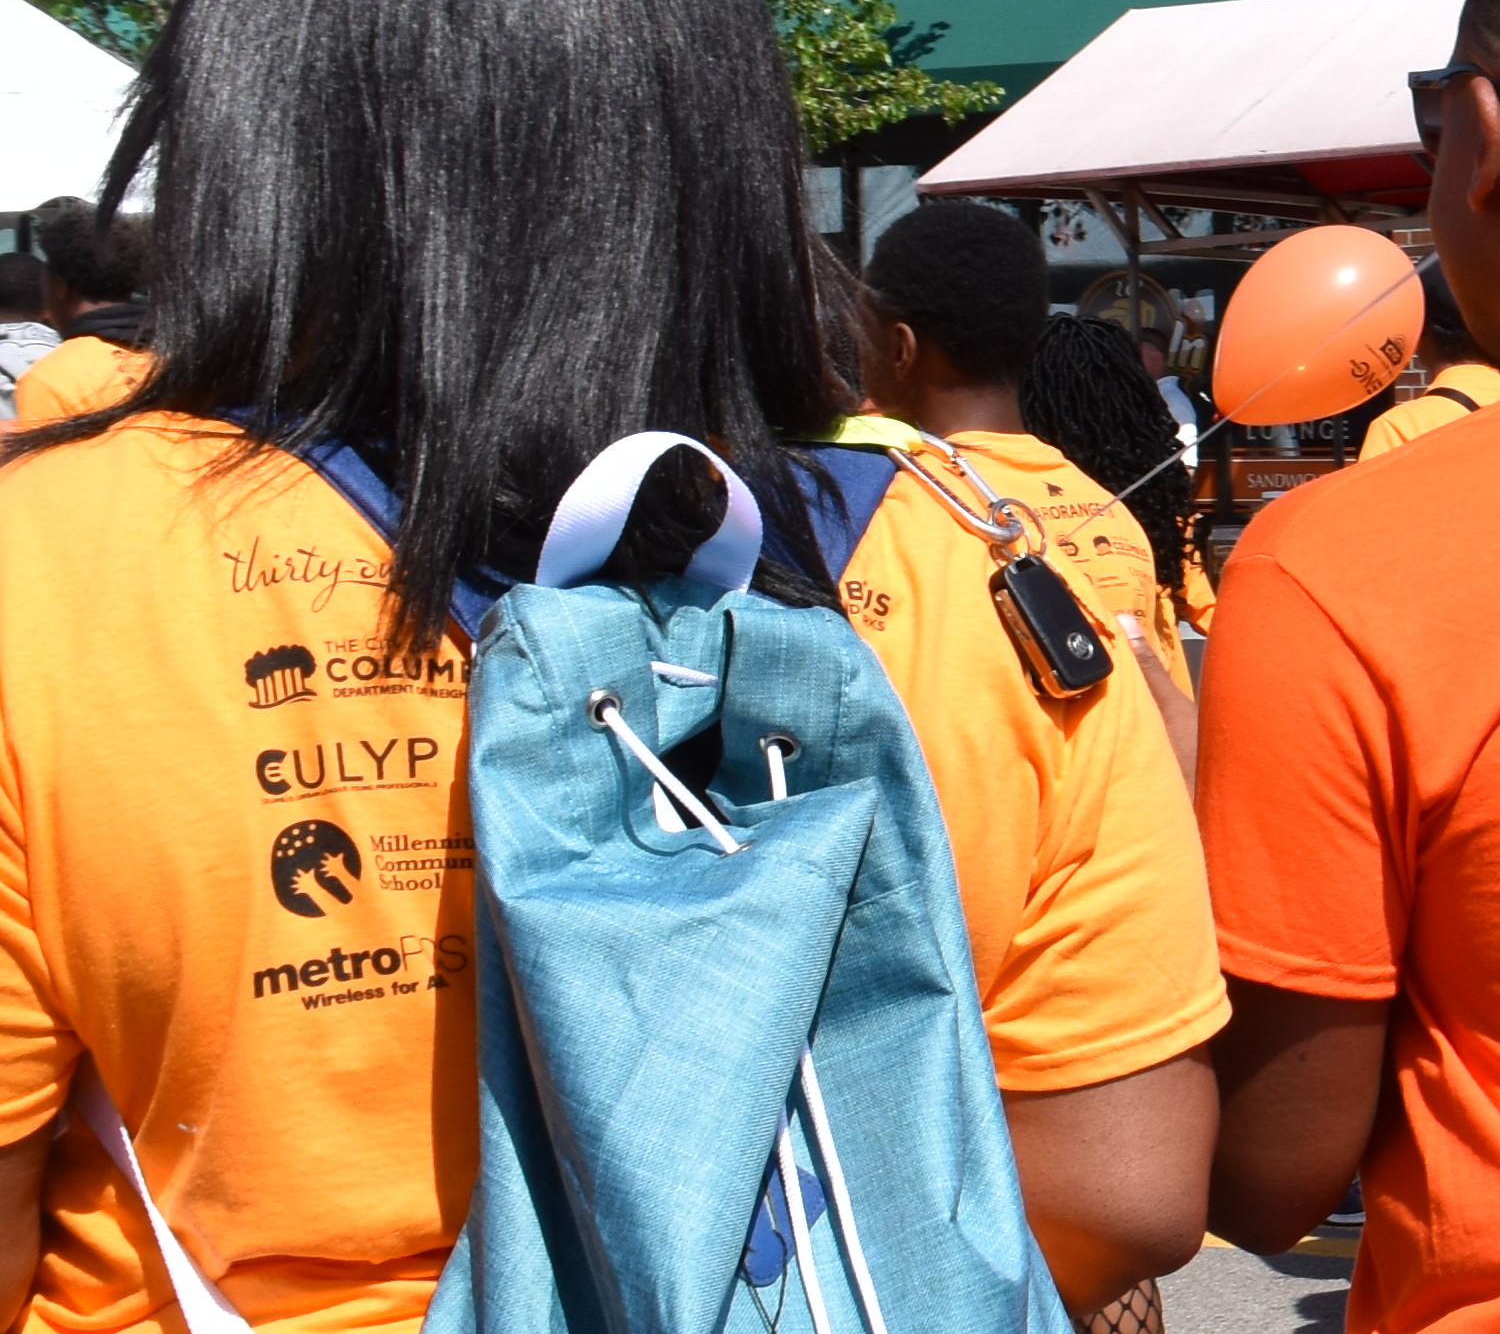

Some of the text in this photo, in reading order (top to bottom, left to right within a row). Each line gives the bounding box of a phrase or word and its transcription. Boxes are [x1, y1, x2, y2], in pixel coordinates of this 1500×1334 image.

[1247, 473, 1320, 490] SANDWIC
[323, 637, 360, 654] THE
[332, 683, 414, 699] DEPARTMENT
[255, 736, 440, 796] CULYP
[379, 872, 441, 892] School
[253, 934, 467, 999] metroPCS
[302, 986, 385, 1011] Wireless
[391, 980, 419, 996] for
